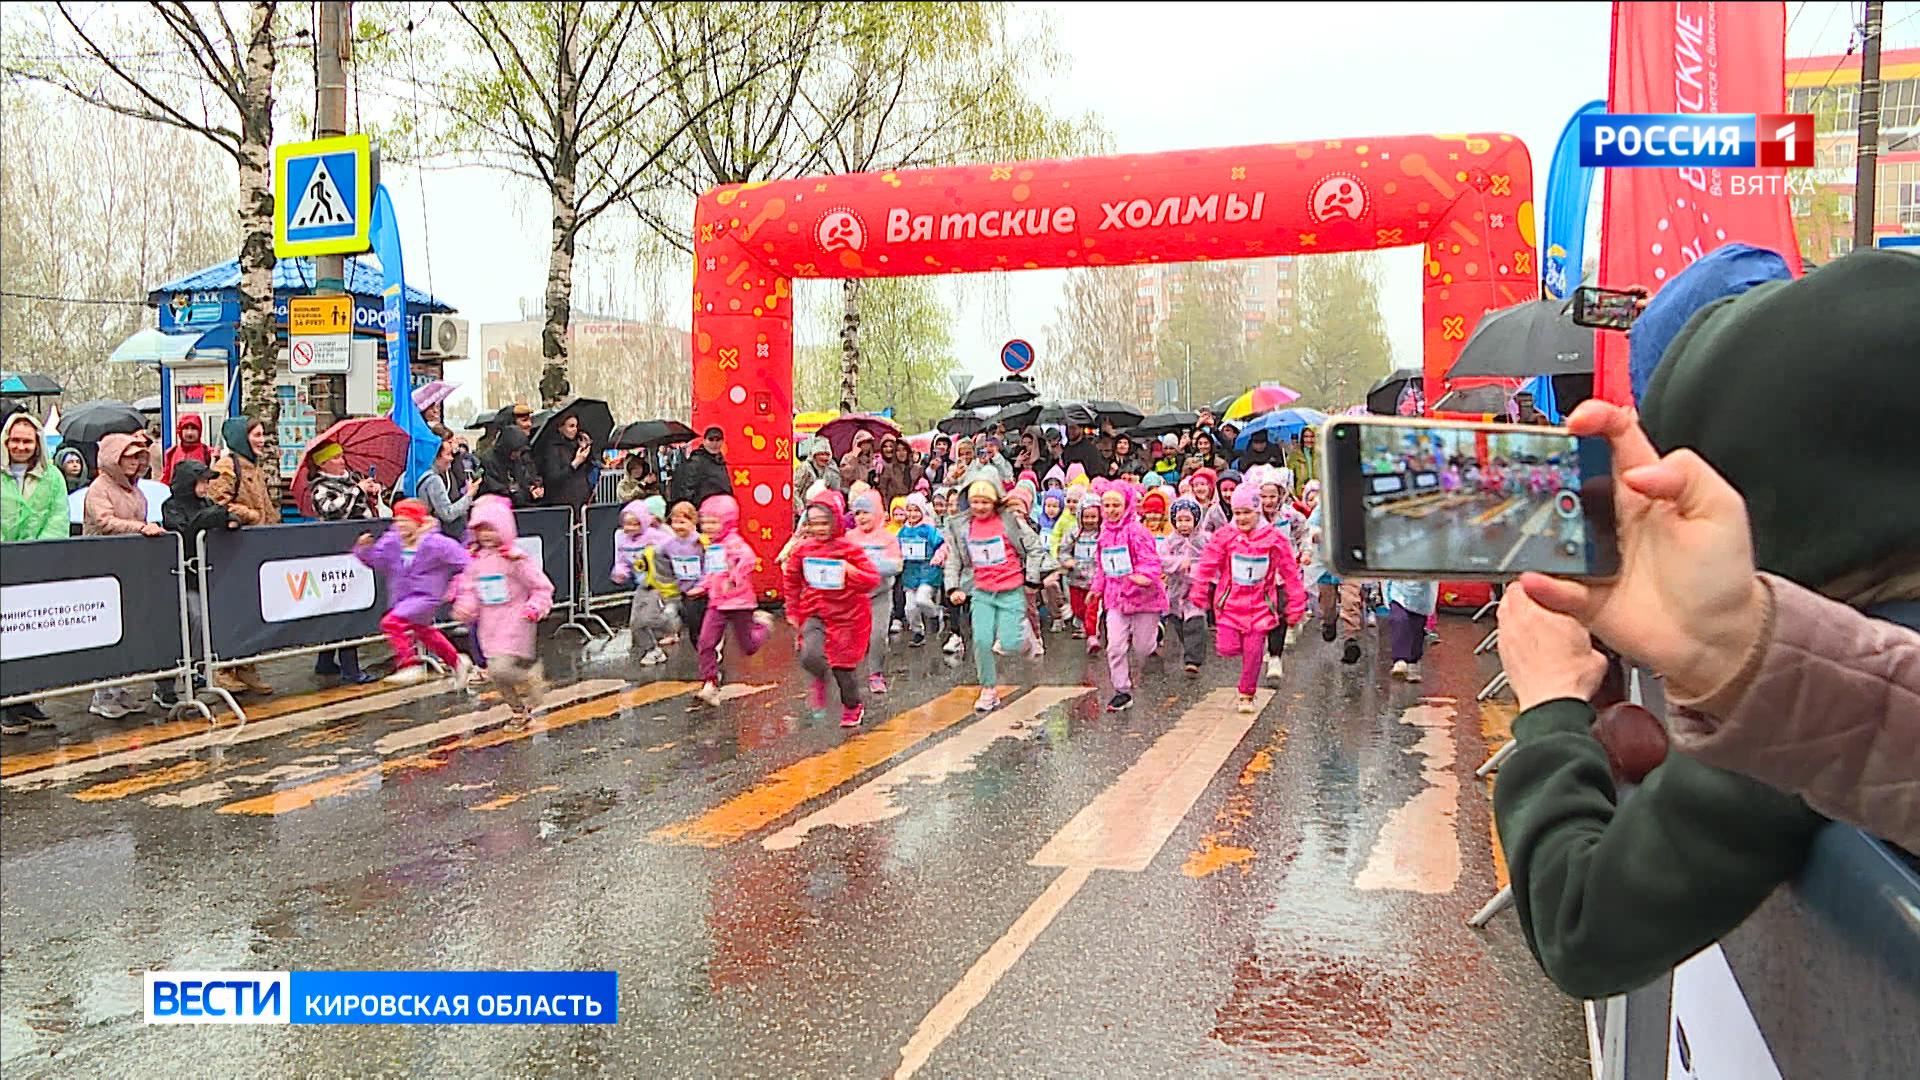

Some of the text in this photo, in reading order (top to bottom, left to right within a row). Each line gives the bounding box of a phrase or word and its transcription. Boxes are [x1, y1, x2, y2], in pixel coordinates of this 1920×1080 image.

[886, 206, 1076, 244] Вятские
[321, 569, 355, 582] ВЯТКА
[332, 582, 347, 594] 2.0
[73, 601, 105, 612] СПОРТА
[57, 614, 97, 627] ОБЛАСТИ
